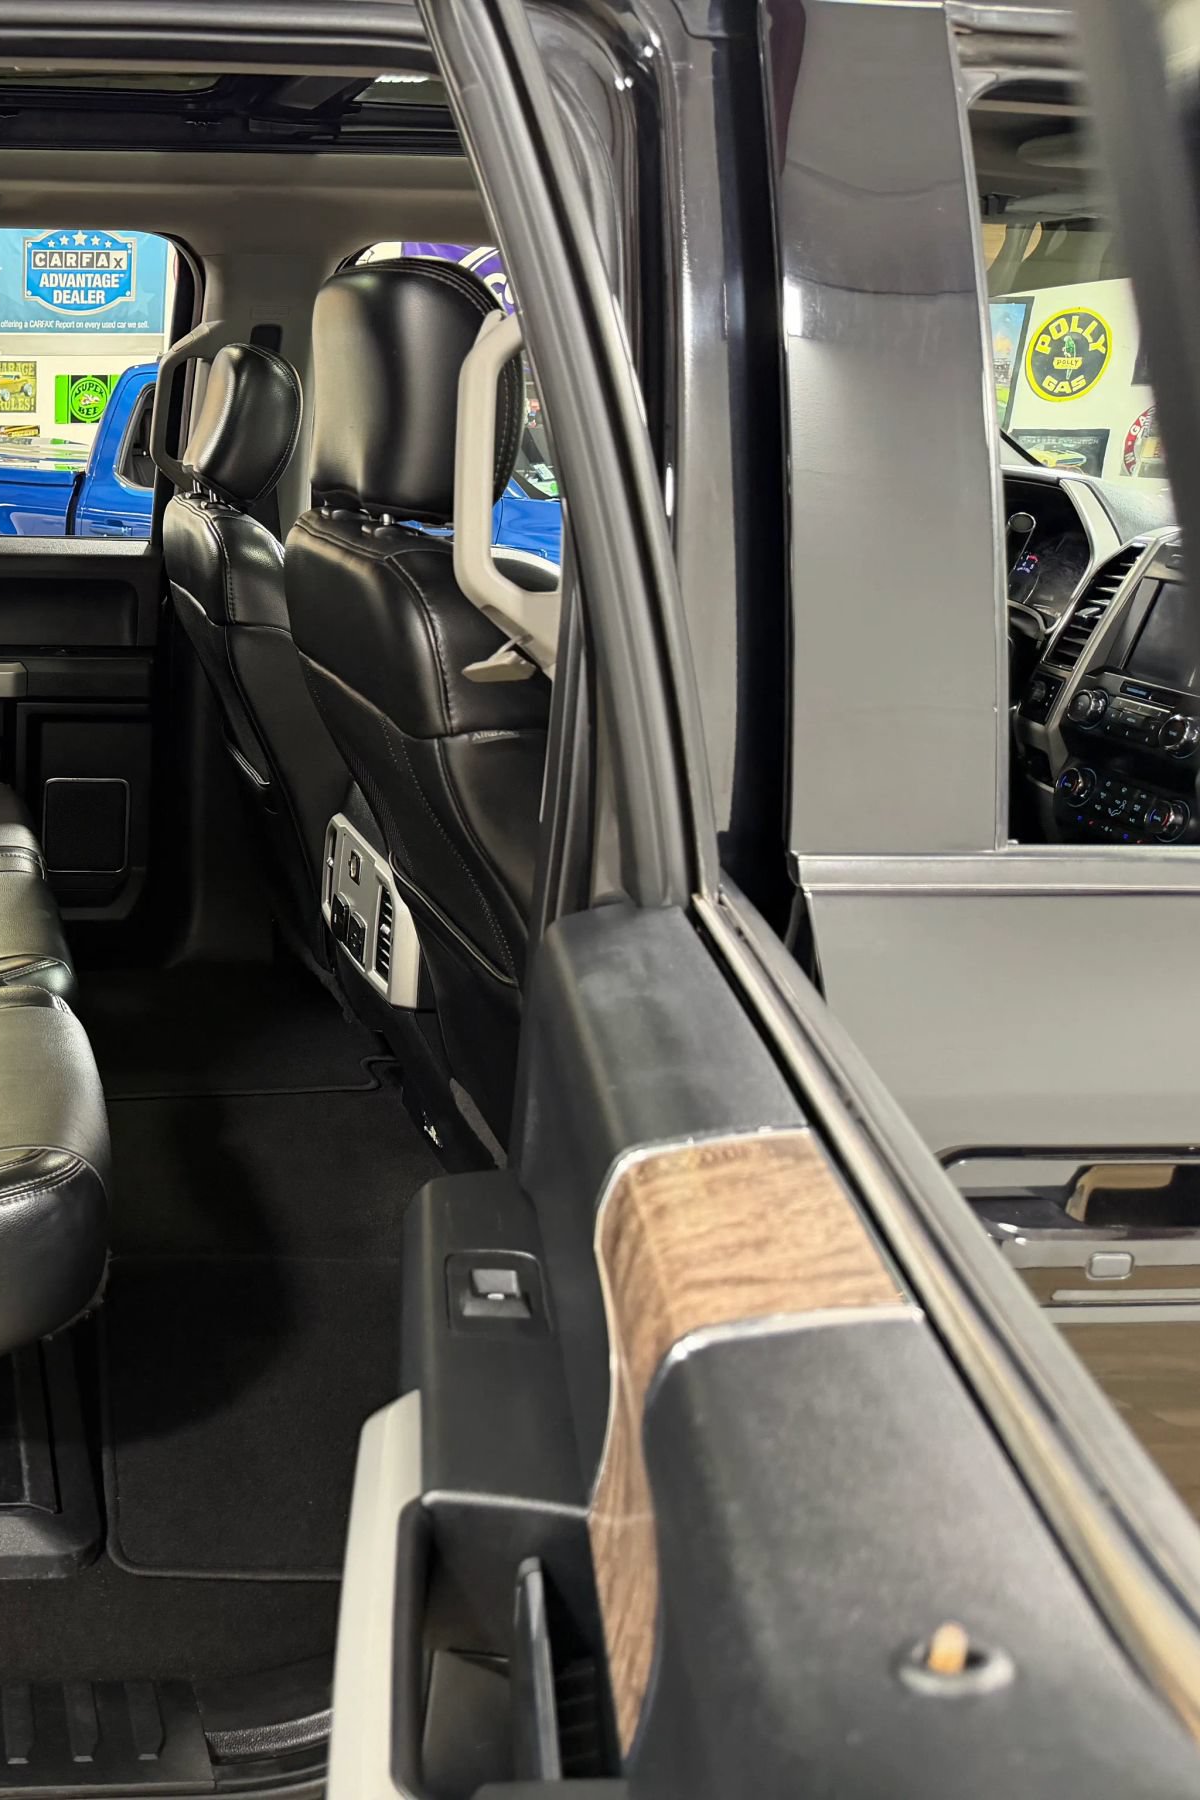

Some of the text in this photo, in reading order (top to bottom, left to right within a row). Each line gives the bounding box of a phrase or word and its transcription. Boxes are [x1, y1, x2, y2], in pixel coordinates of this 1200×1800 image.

[33, 251, 124, 269] CARFAX
[39, 273, 120, 288] ADVANTAGE
[53, 290, 106, 304] DEALER
[1, 320, 22, 329] offering
[29, 320, 52, 328] CARFAX
[55, 320, 75, 329] Report
[85, 321, 100, 330] every
[102, 320, 115, 329] used
[137, 320, 150, 329] sell.
[1035, 315, 1107, 354] POLLY
[74, 382, 104, 397] SUPER
[1042, 375, 1087, 394] GAS
[78, 406, 98, 416] BEE
